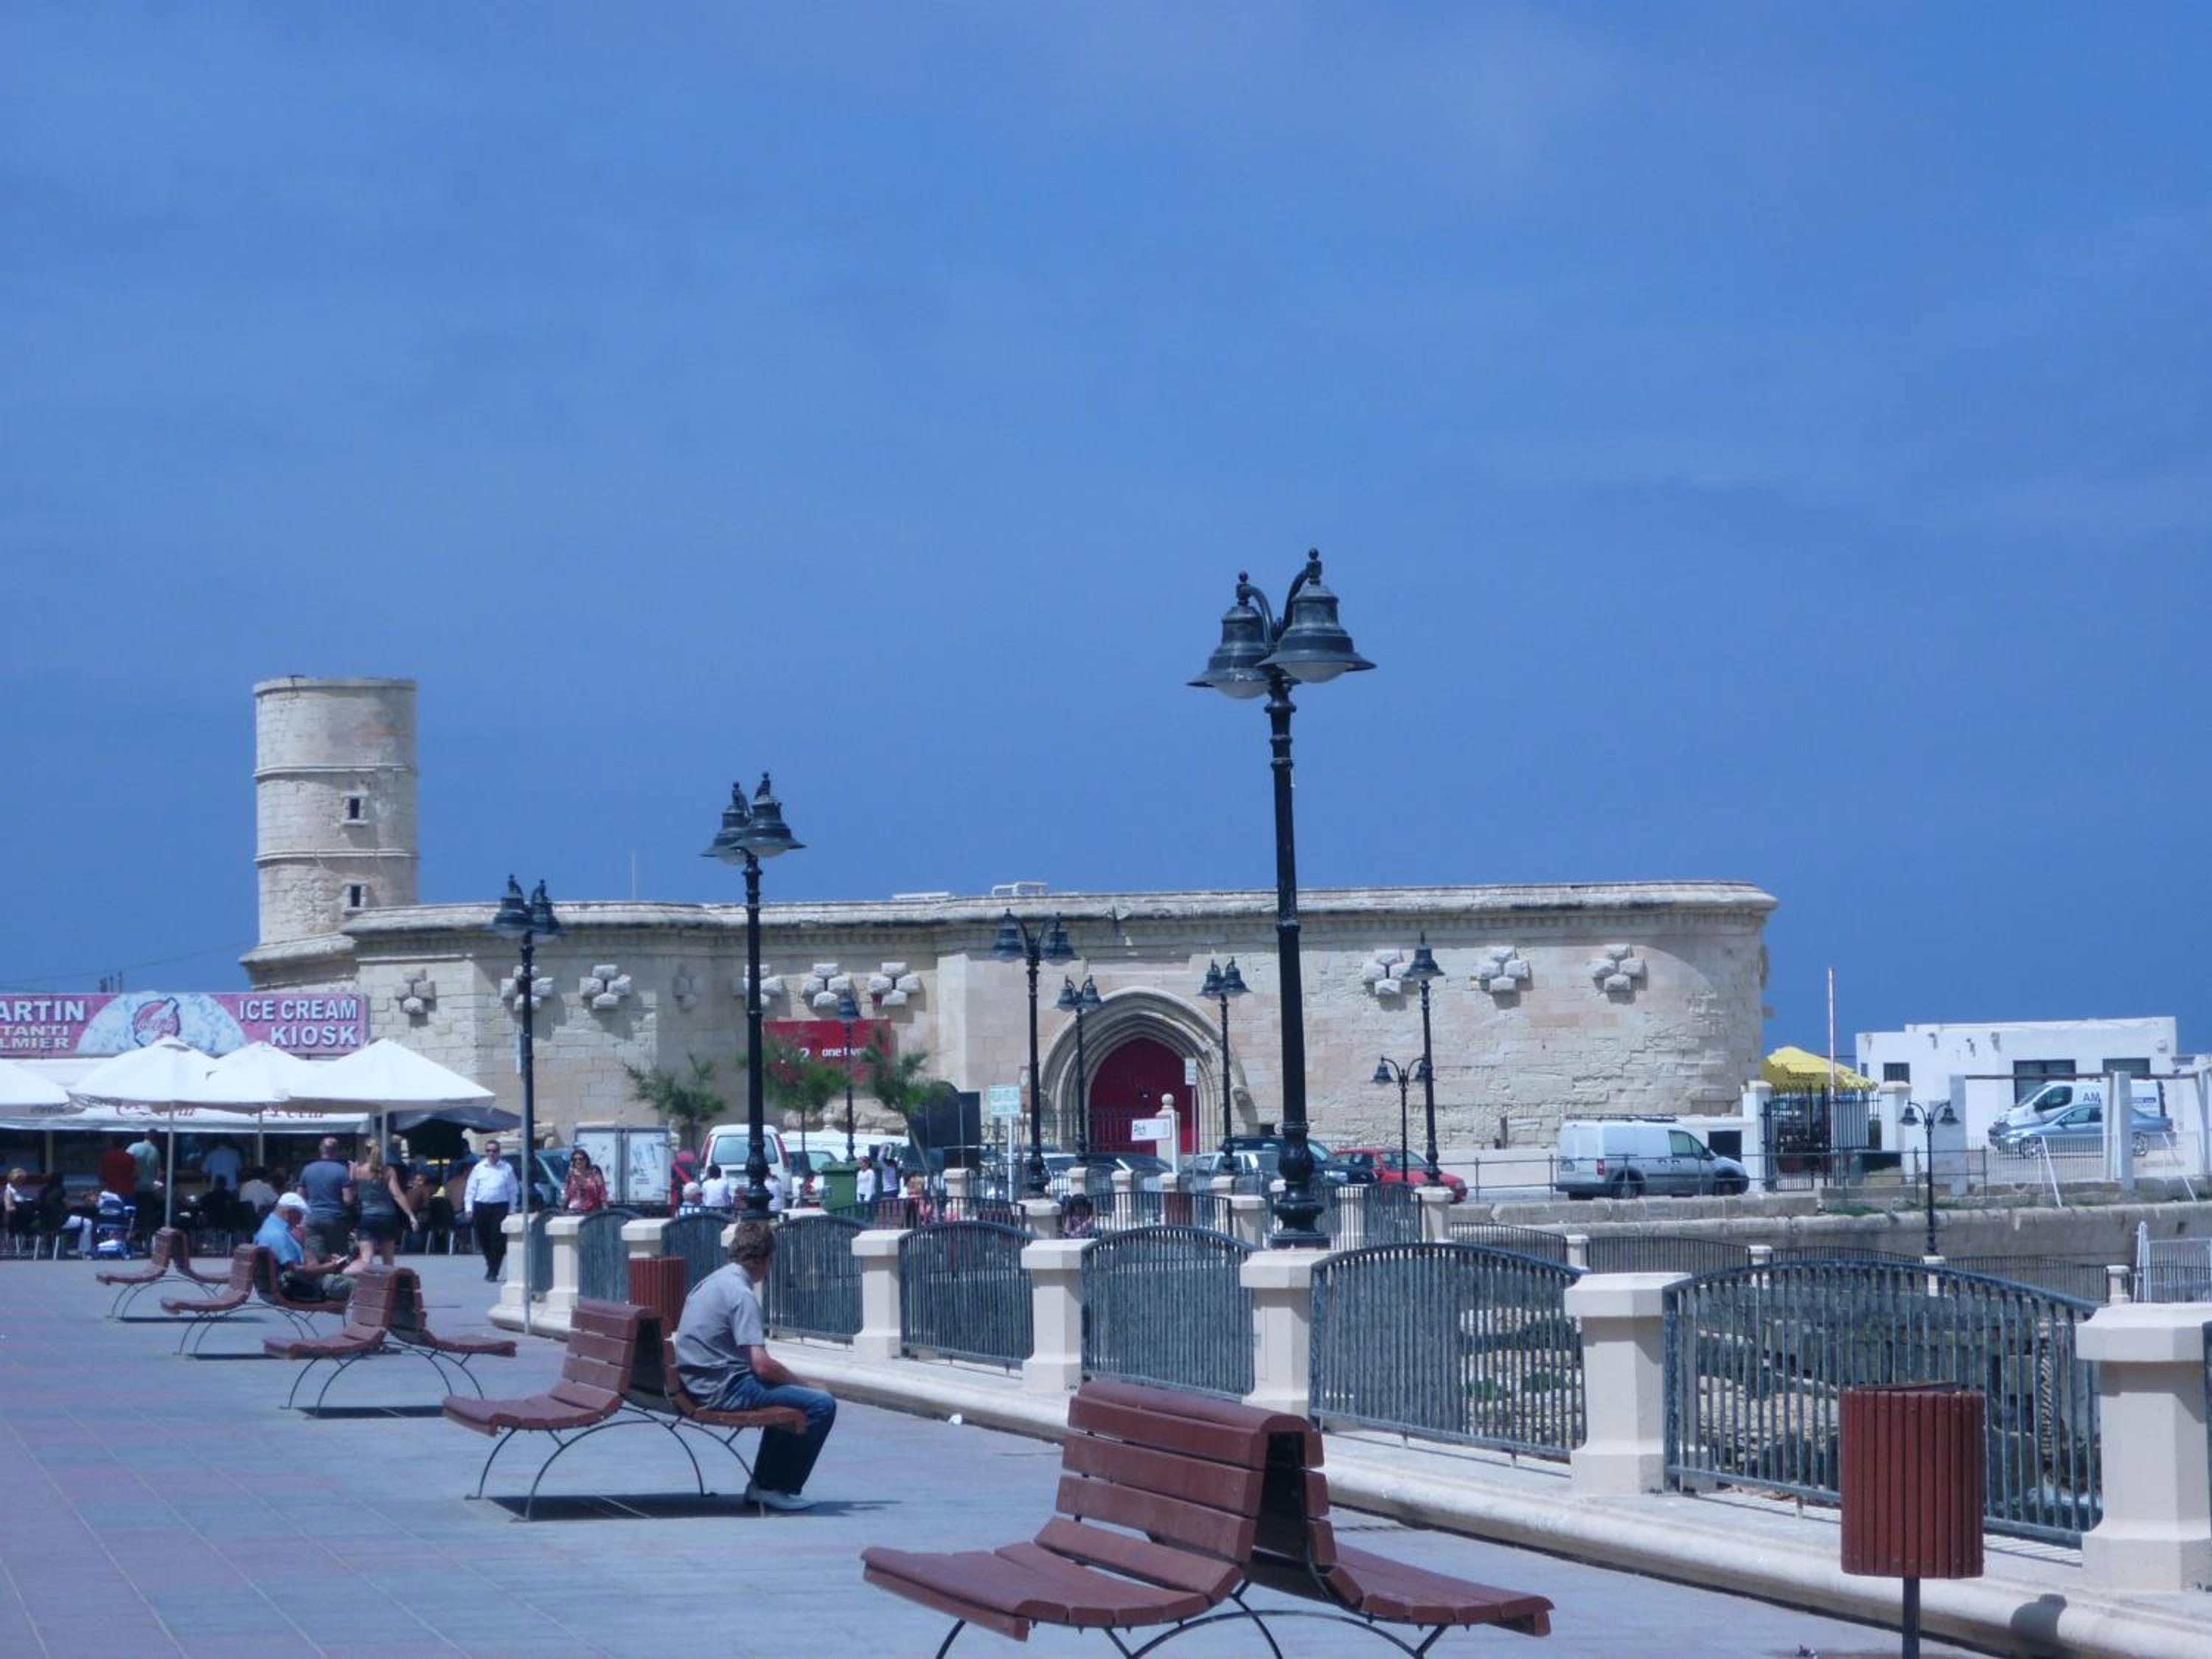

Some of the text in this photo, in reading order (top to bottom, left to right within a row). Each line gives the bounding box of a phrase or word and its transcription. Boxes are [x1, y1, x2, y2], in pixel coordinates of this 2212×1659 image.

[239, 999, 358, 1020] ICE CREAM
[271, 1026, 358, 1046] KIOSK
